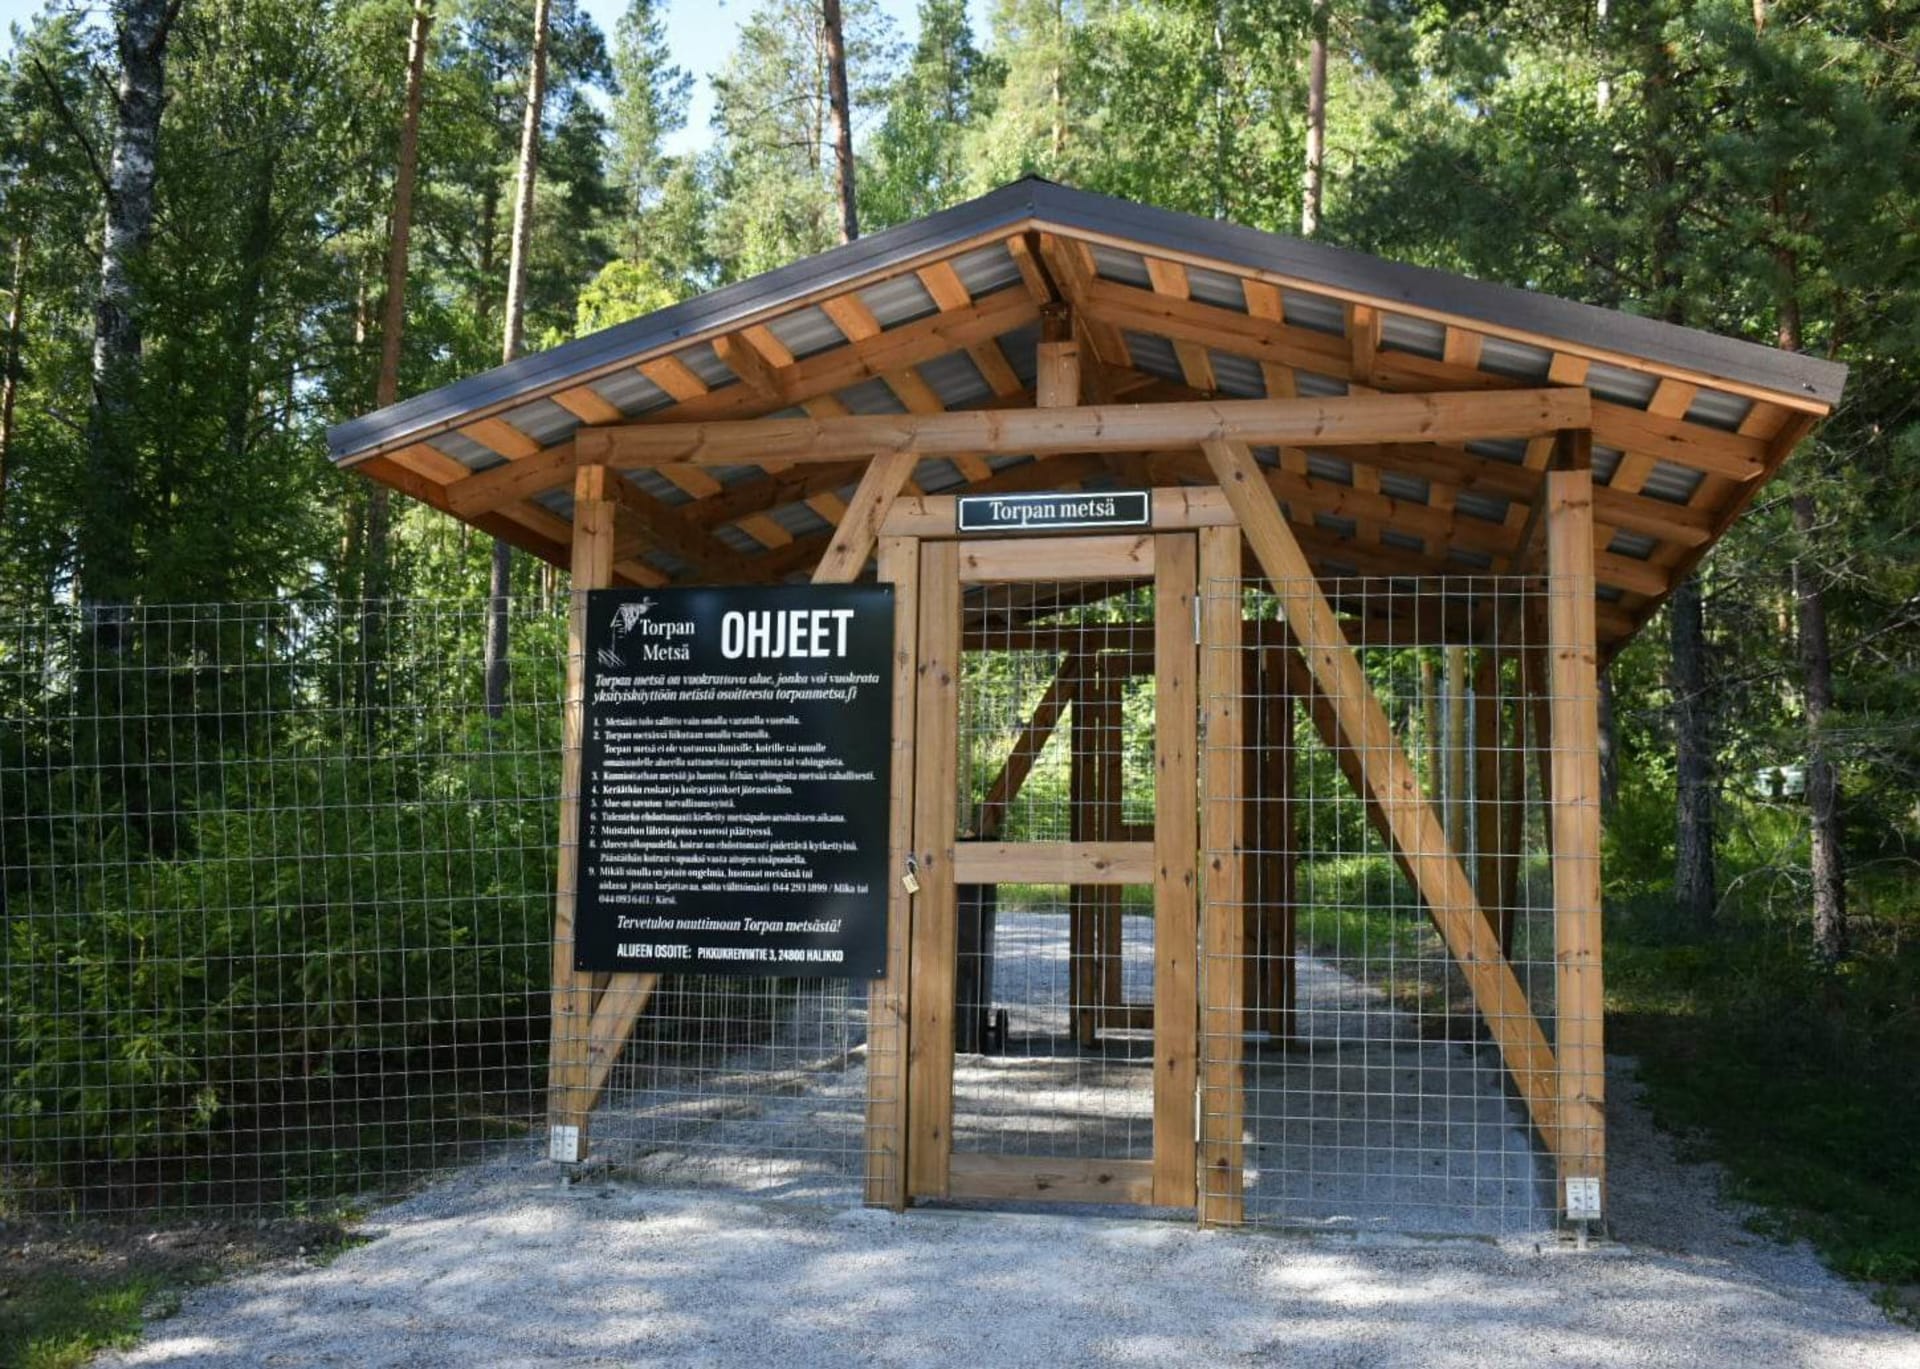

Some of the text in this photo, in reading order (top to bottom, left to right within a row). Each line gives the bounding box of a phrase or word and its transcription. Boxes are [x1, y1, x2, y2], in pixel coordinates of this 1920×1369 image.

[989, 498, 1116, 525] Torpan metsä
[641, 618, 695, 641] Torpan
[721, 609, 855, 660] OHJEET
[643, 643, 690, 662] Metsä
[595, 674, 632, 689] Torpan
[633, 673, 666, 687] metsä
[667, 675, 680, 685] on
[683, 673, 747, 685] vuokrattava
[775, 672, 808, 688] jonka
[811, 672, 828, 684] voi
[829, 671, 880, 684] vuokrata
[592, 685, 858, 705] yksityiskäyttöön netistä osoitteesta torpanmetsa.fi
[701, 716, 728, 725] omalla
[593, 731, 601, 740] 2.
[604, 731, 632, 742] Torpan
[604, 744, 632, 756] Torpan
[633, 745, 656, 753] metsä
[657, 744, 665, 753] ei
[666, 744, 678, 753] ole
[679, 744, 717, 753] vastuussa
[756, 743, 785, 753] koirille
[786, 743, 797, 752] tai
[798, 743, 827, 752] muulle
[784, 758, 794, 767] tai
[687, 771, 696, 783] ja
[644, 785, 671, 795] roskasi
[671, 785, 680, 796] ja
[681, 784, 708, 795] koirasi
[601, 826, 645, 836] Muistathan
[699, 826, 728, 836] vuorosi
[600, 867, 625, 876] Mikäli
[626, 867, 652, 877] sinulla
[653, 869, 663, 877] on
[663, 868, 687, 879] jotain
[728, 867, 763, 878] huomaat
[764, 868, 801, 879] metsässä
[802, 869, 814, 879] tai
[617, 914, 843, 936] Tervetuloa nauttimaan Torpan metsästä!
[616, 943, 653, 958] ALUEEN
[654, 944, 692, 959] OSOITE:
[769, 949, 778, 962] 3,
[778, 948, 806, 962] 24800
[806, 949, 844, 963] HALIKKO
